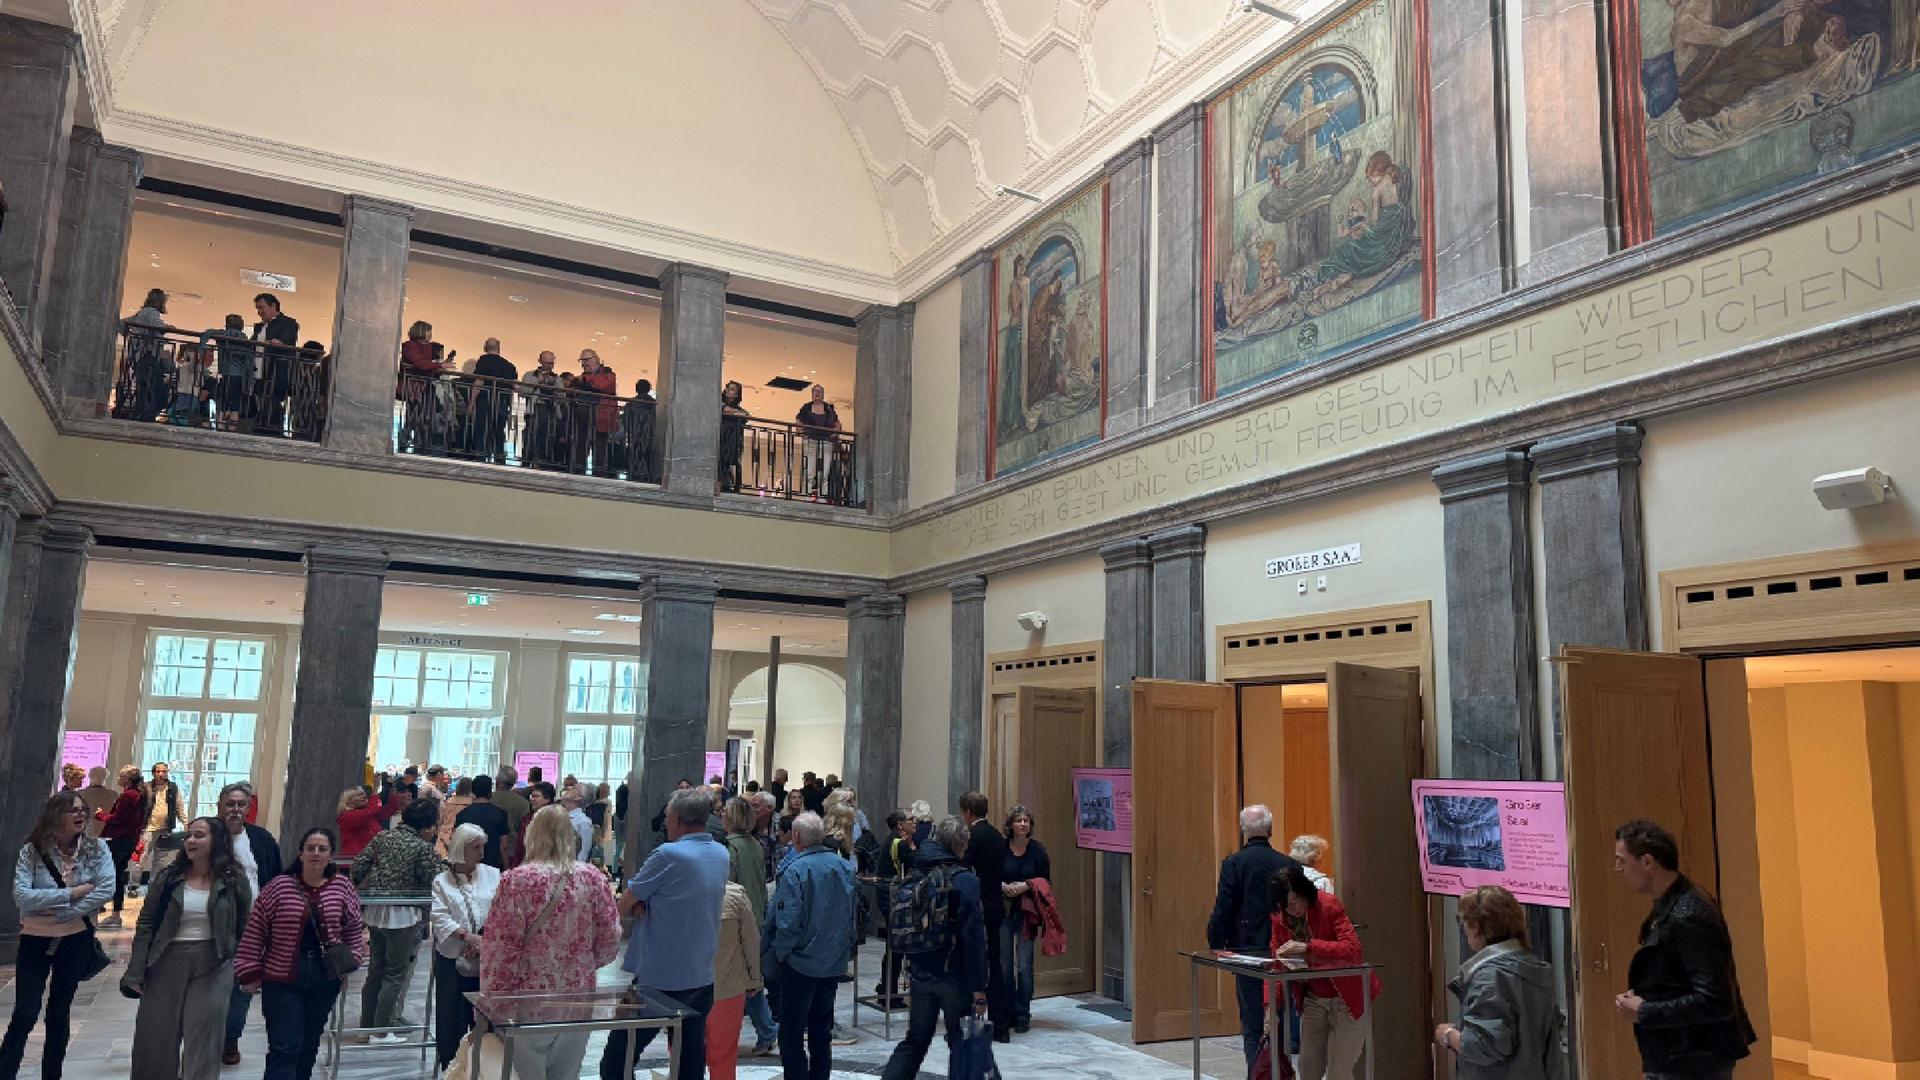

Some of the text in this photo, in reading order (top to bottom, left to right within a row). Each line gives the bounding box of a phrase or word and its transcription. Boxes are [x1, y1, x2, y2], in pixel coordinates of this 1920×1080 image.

[1057, 490, 1109, 521] GEST
[1296, 390, 1443, 456] FREUDIG
[1473, 368, 1519, 405] IM
[1551, 256, 1884, 384] FESTLICHEN
[1166, 431, 1215, 463] UND
[1235, 406, 1291, 443] BAD
[1315, 320, 1543, 417] GESUNDHEIT
[1575, 247, 1773, 335] WIEDER
